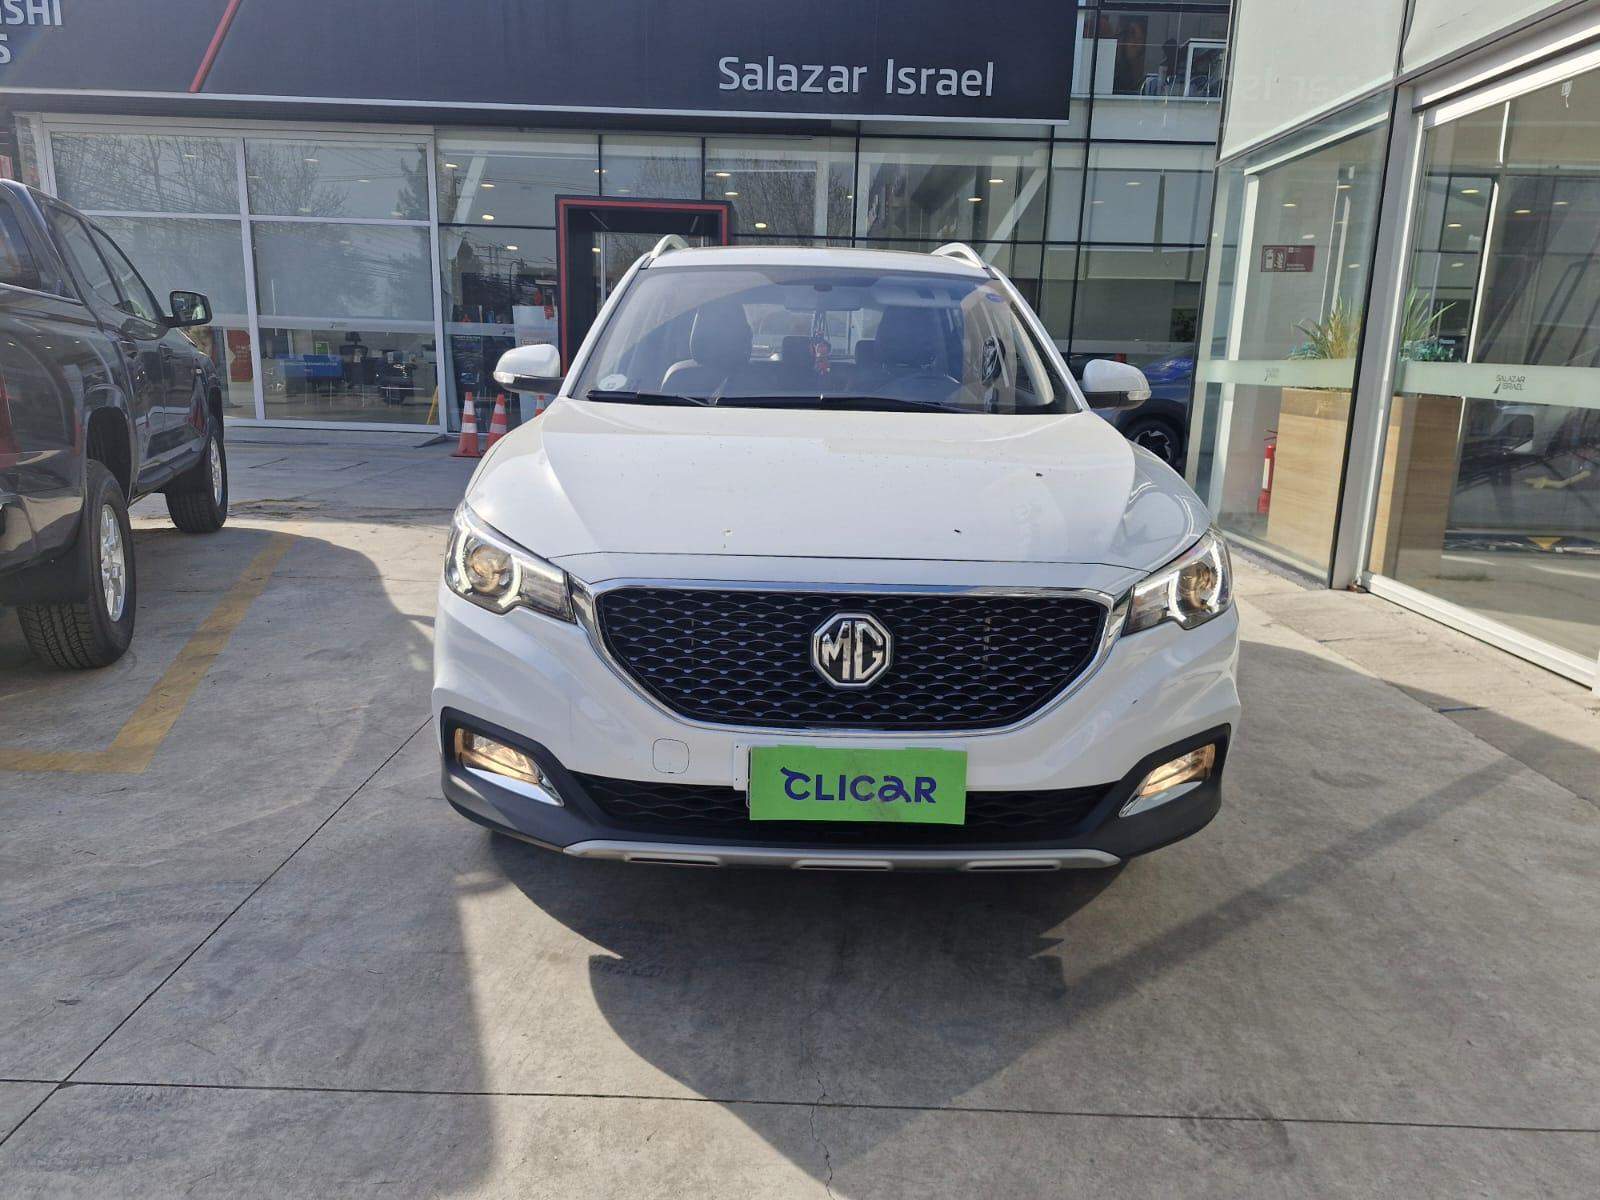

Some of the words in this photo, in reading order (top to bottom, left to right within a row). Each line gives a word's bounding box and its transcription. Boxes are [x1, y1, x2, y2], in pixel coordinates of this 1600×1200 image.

[718, 55, 868, 93] Salazar
[885, 58, 994, 97] Israel
[821, 620, 884, 681] MG
